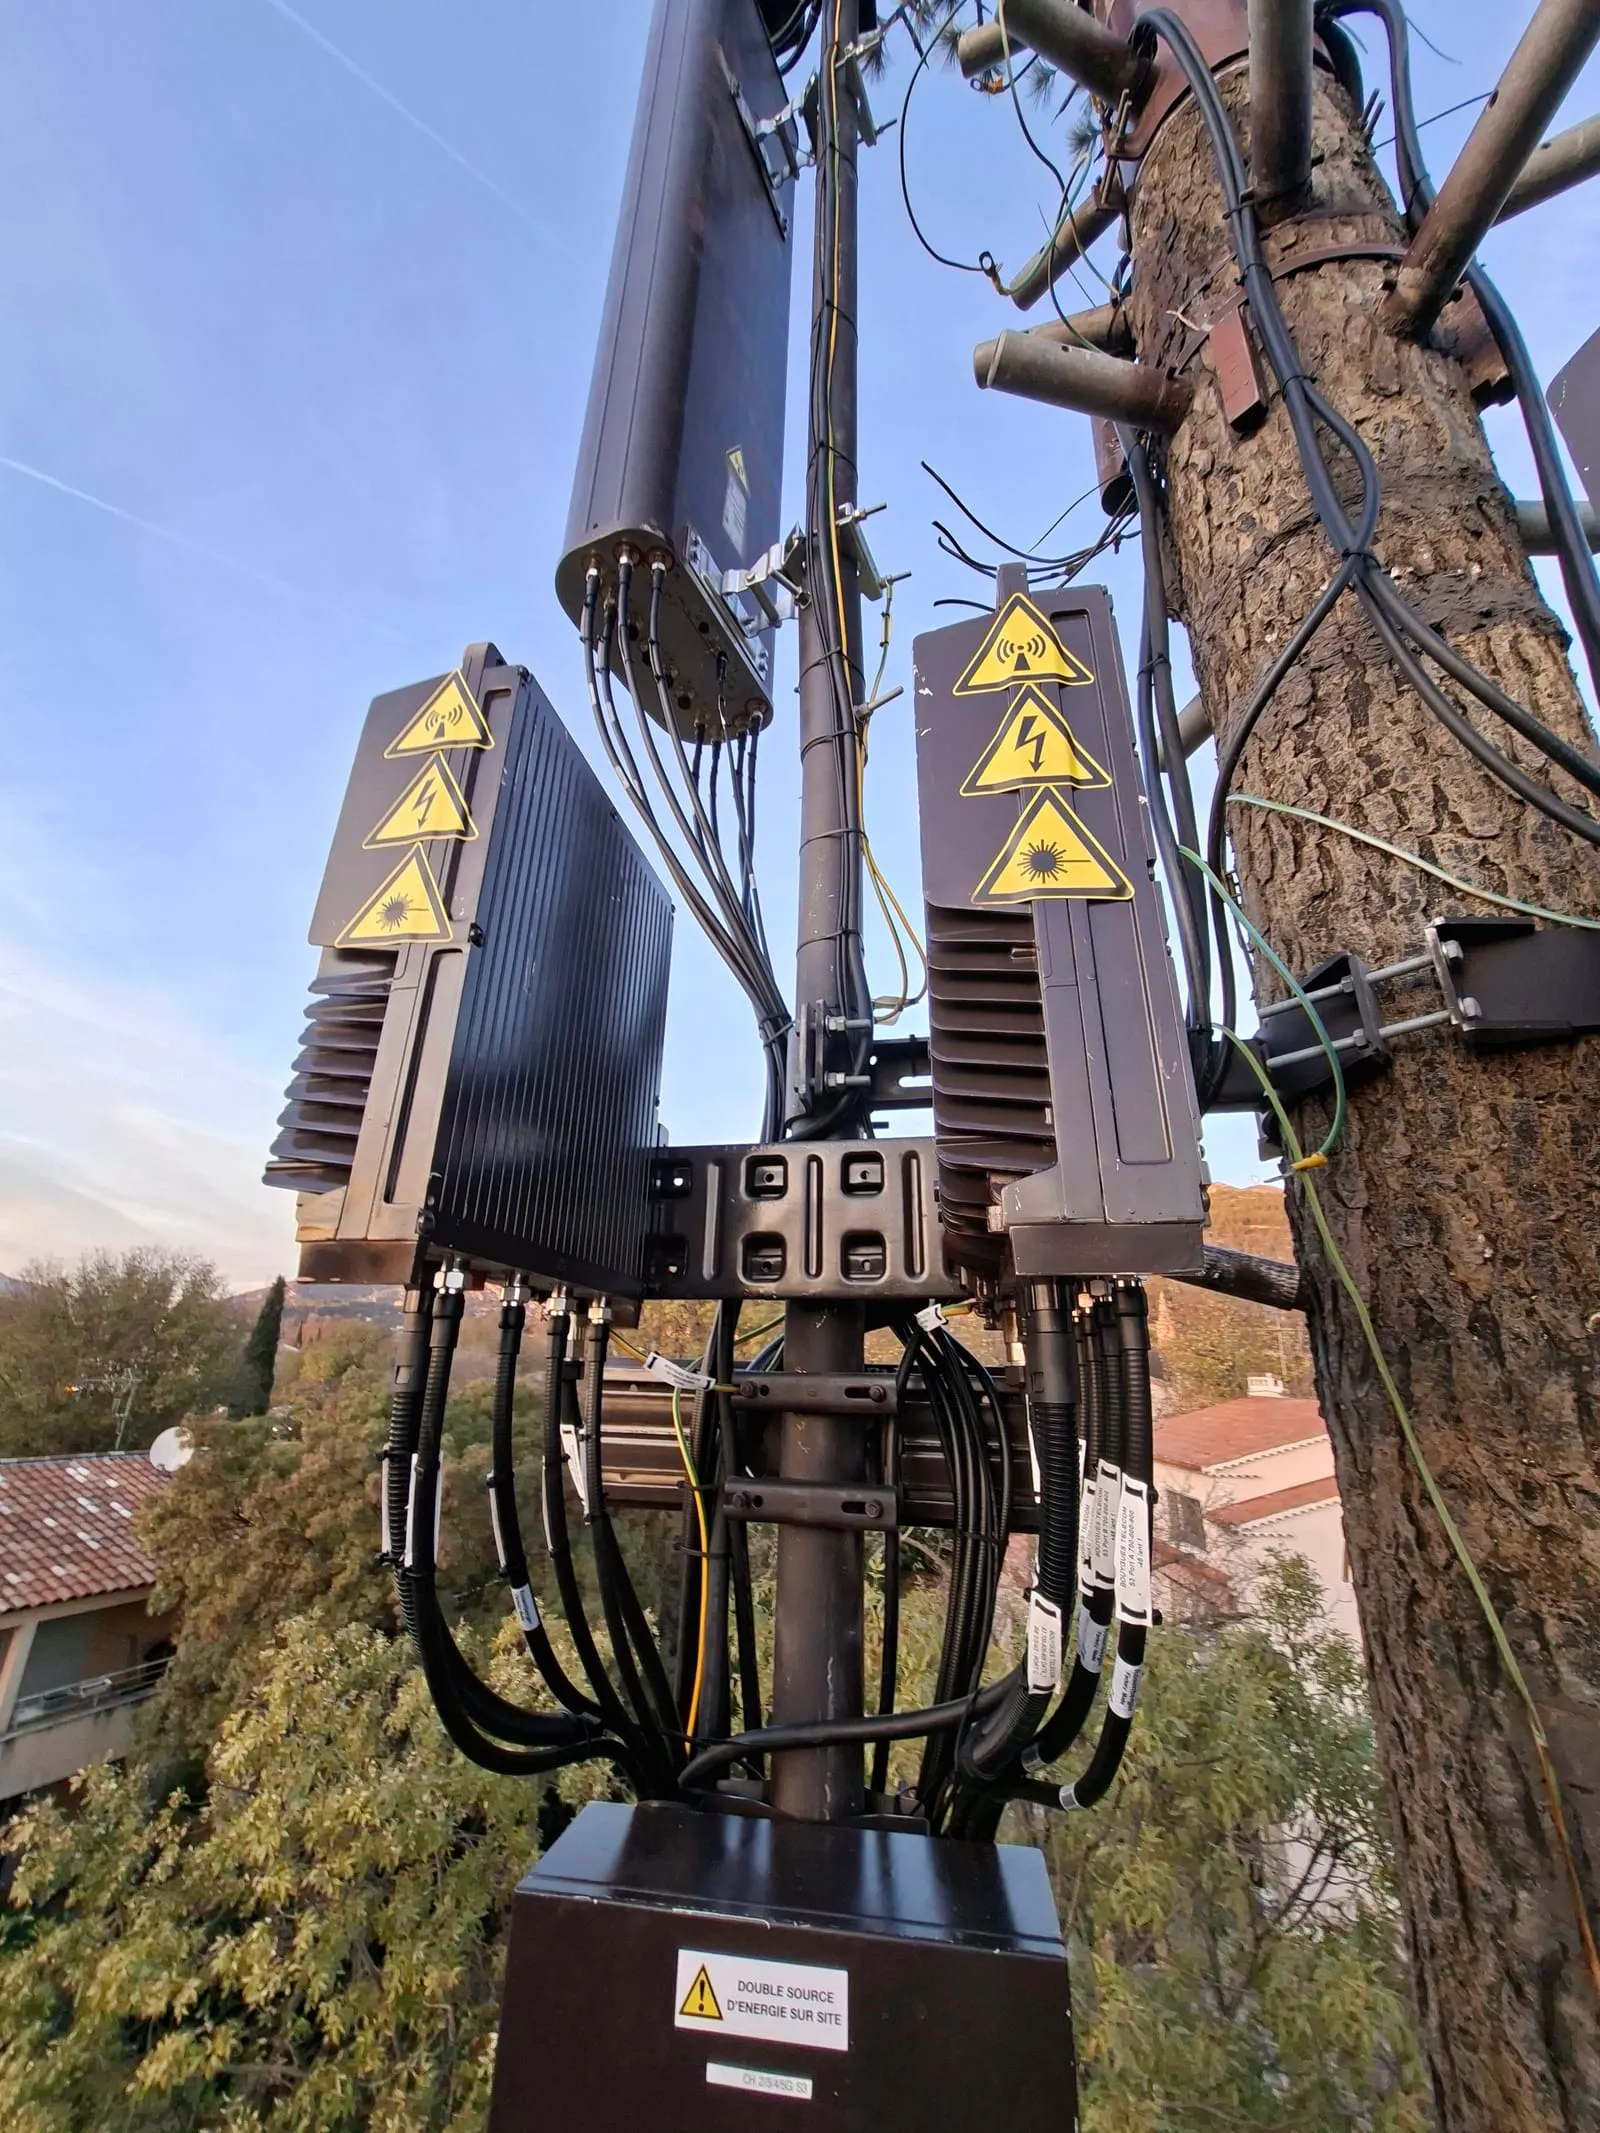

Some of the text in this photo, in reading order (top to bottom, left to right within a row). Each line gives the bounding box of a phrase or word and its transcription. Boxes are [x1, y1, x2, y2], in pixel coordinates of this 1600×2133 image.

[738, 1980, 834, 2004] DOUBLE SOURCE
[727, 1999, 842, 2025] D'ENERGIE SUR SITE
[795, 2082, 808, 2094] S3
